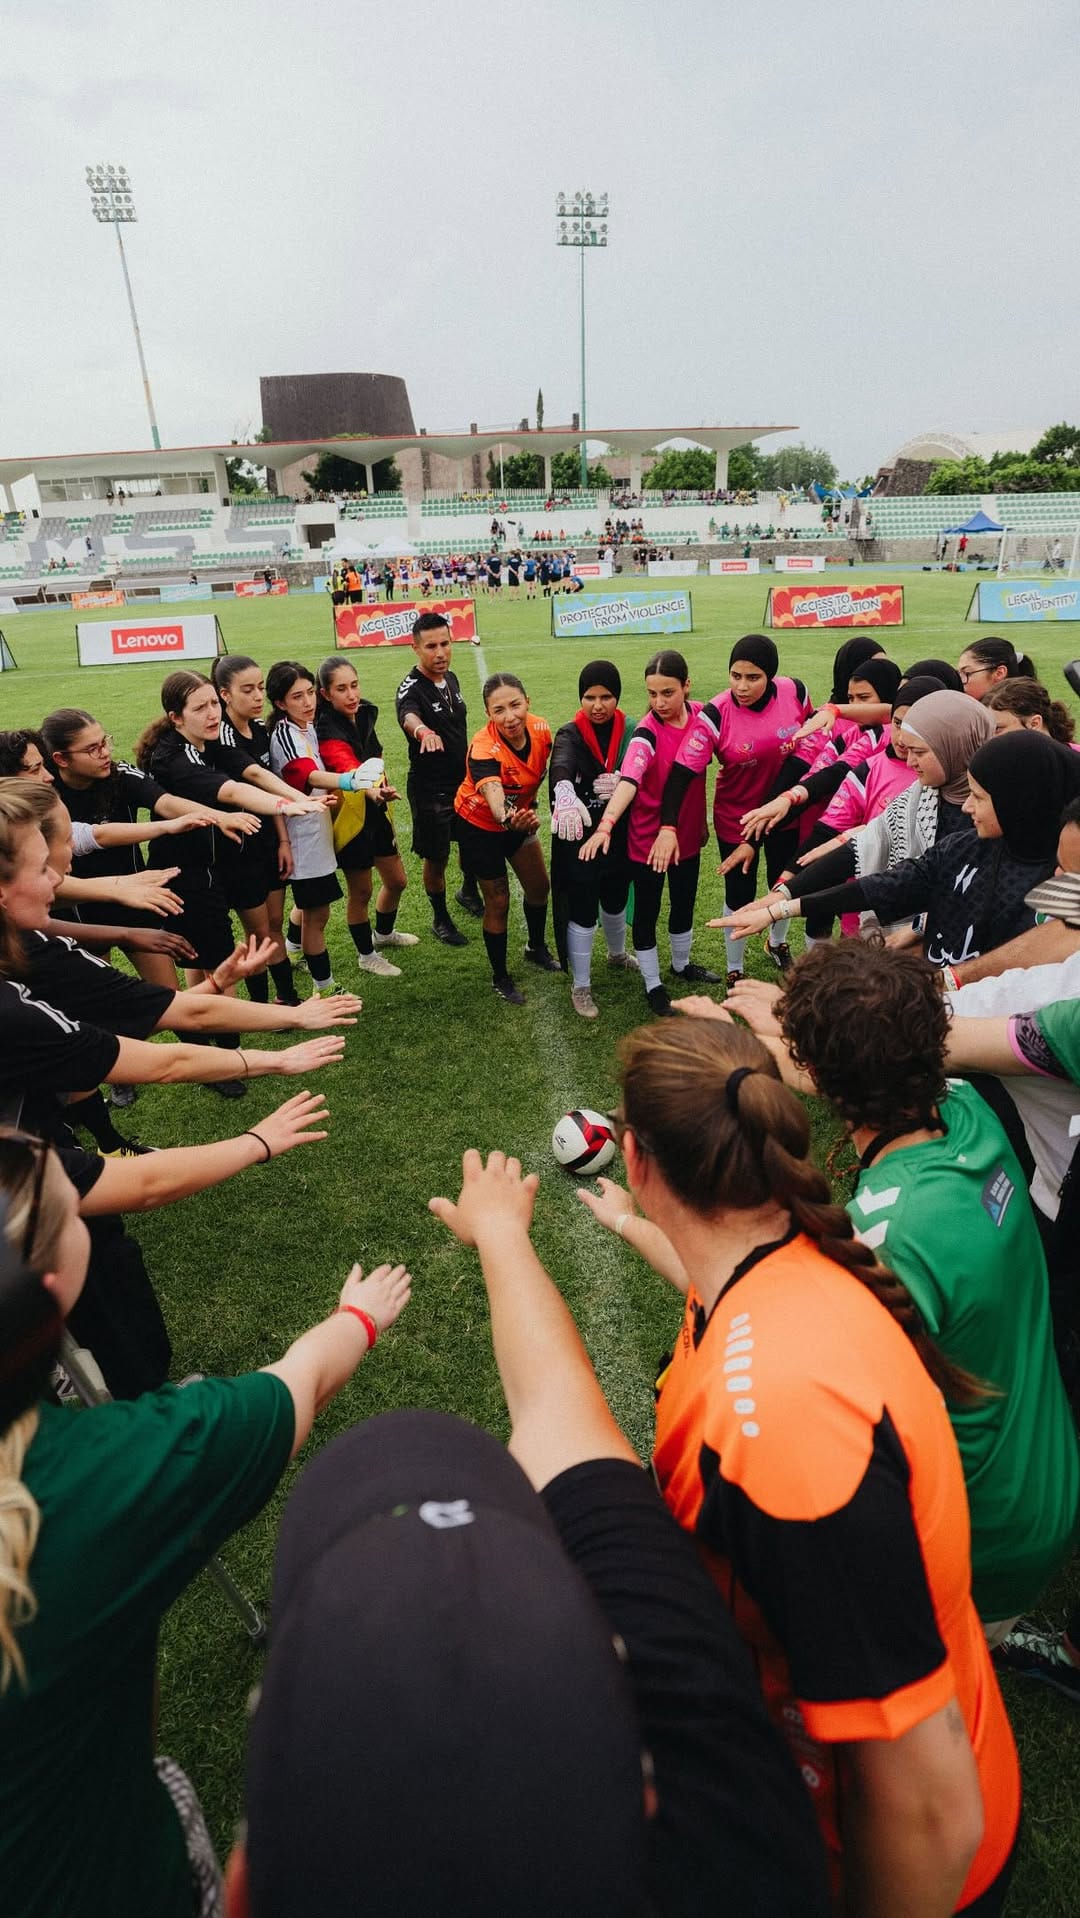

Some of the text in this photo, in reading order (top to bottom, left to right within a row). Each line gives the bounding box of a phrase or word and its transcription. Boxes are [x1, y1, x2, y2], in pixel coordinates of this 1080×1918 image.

[795, 594, 850, 614] ACCESS TO
[818, 598, 880, 620] EDUCATION
[1007, 591, 1041, 606] LEGAL
[1030, 594, 1076, 612] IDENTITY
[360, 611, 418, 634] ACCESS TO
[559, 601, 629, 625] PROTECTION
[594, 599, 686, 628] FROM VIOLENCE
[117, 633, 178, 648] Lenovo
